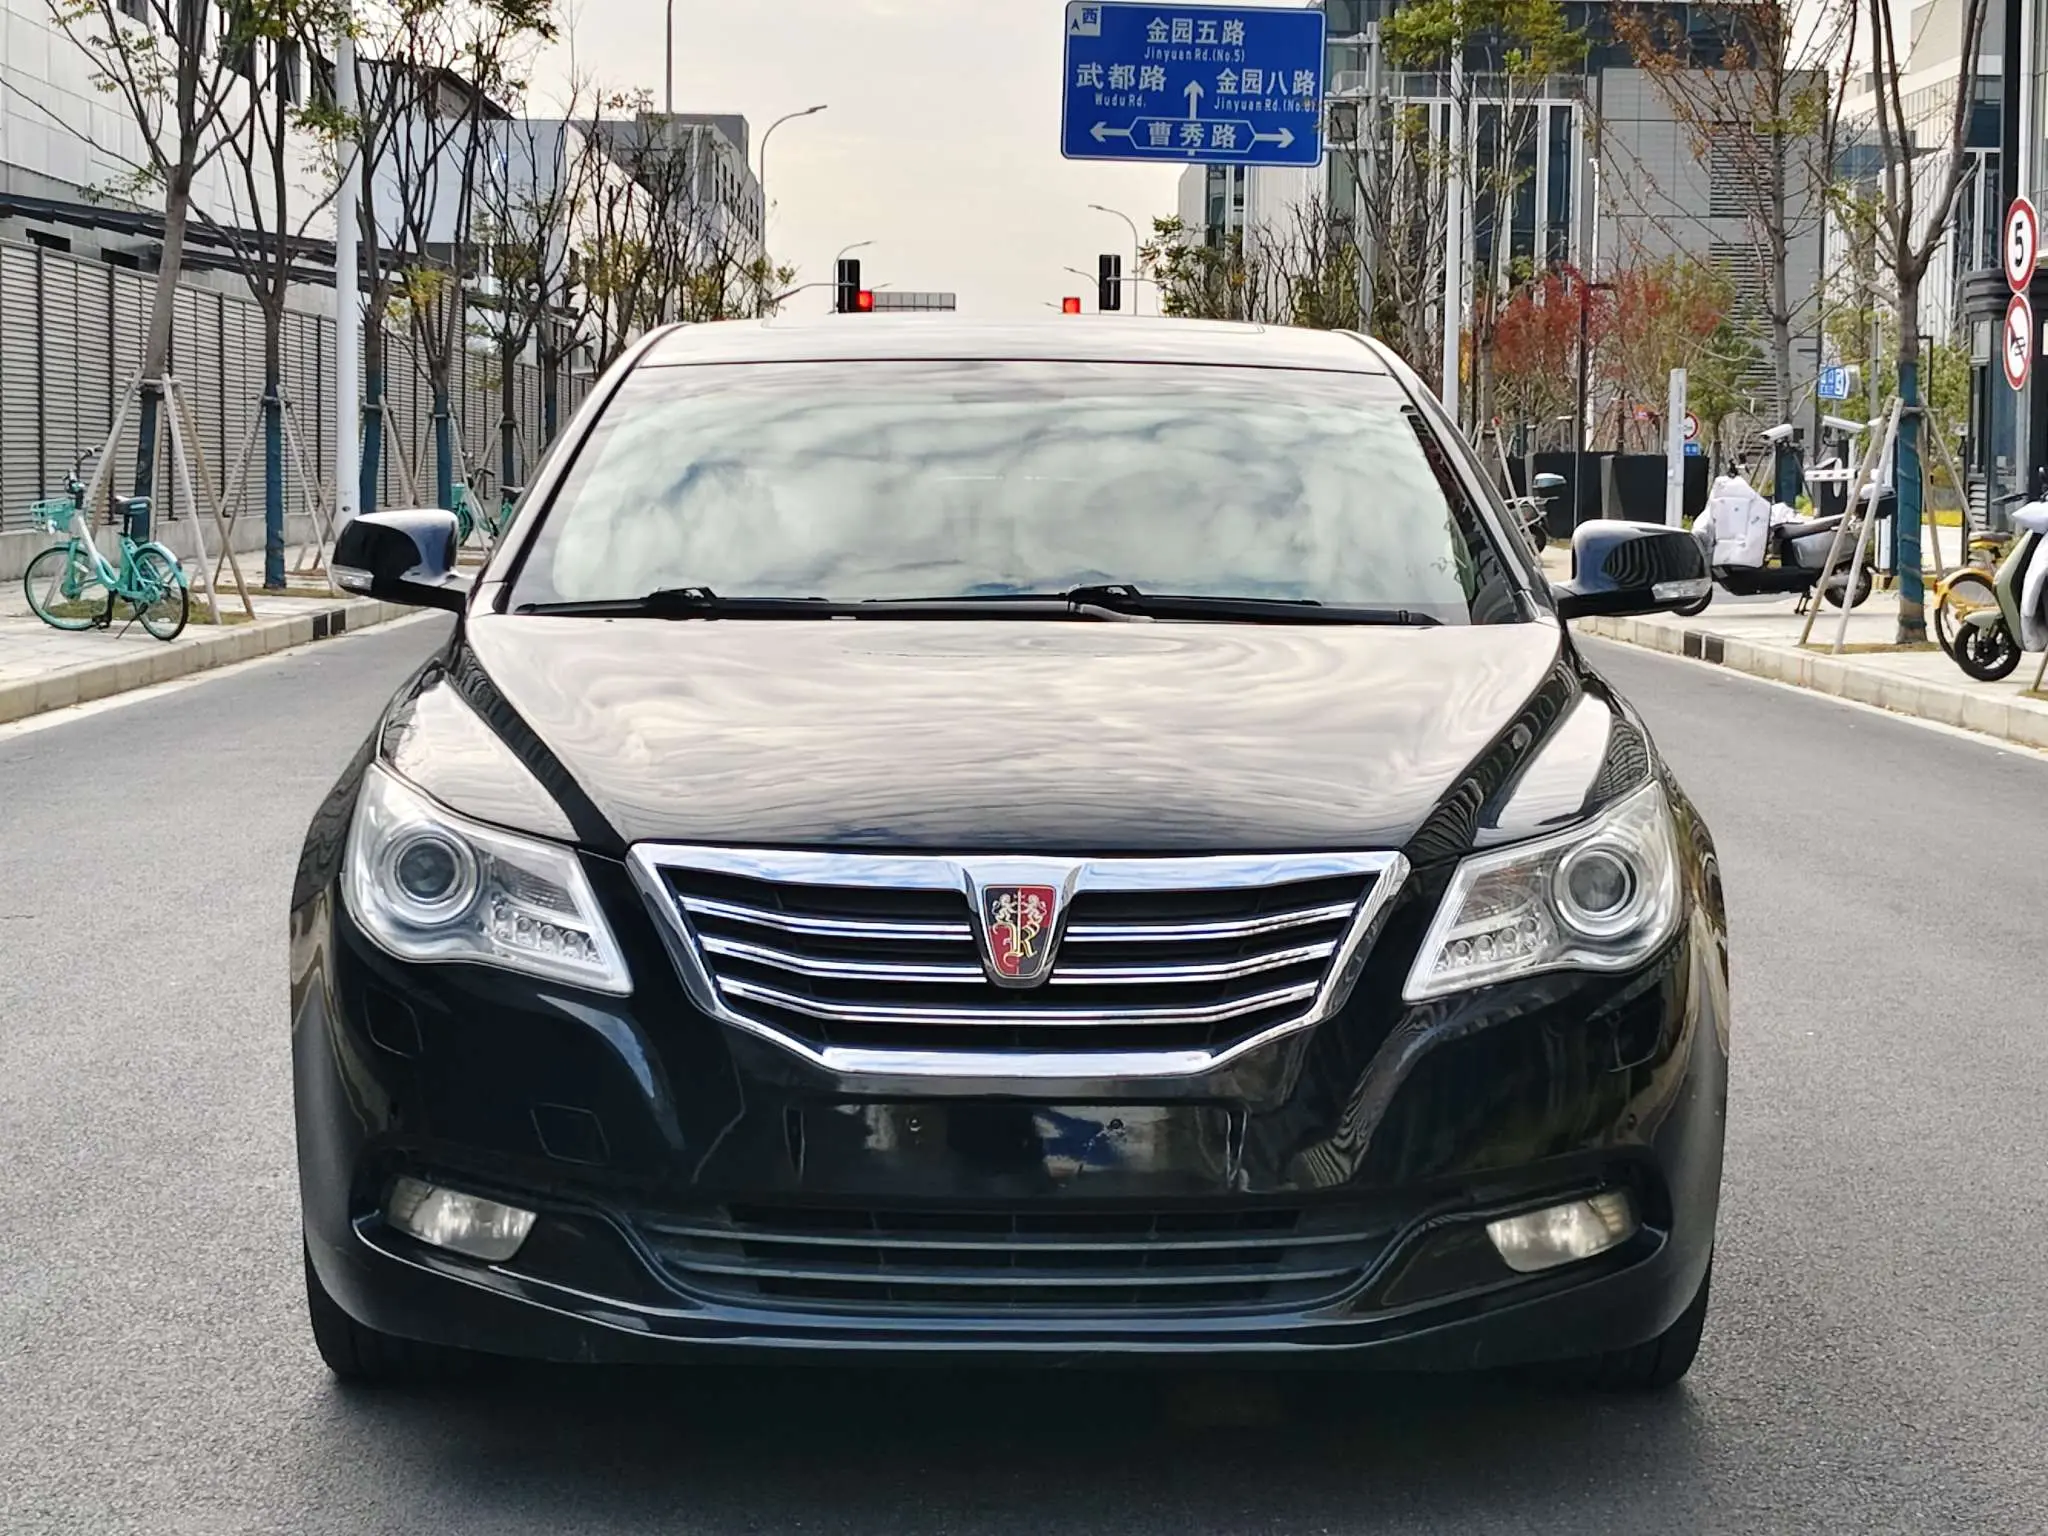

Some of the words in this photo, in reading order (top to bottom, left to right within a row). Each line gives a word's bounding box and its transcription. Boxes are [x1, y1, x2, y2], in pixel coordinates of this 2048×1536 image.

[1081, 7, 1098, 25] 西
[1146, 17, 1246, 47] 金园五路
[1144, 46, 1192, 63] Jinyuan
[1076, 62, 1168, 92] 武都路
[1216, 68, 1316, 98] 金园八路
[1095, 91, 1126, 108] Wudu
[1128, 93, 1147, 108] Rd.
[1214, 96, 1262, 113] Jinyuan
[1148, 121, 1238, 149] 曹秀路
[2014, 220, 2024, 268] 5
